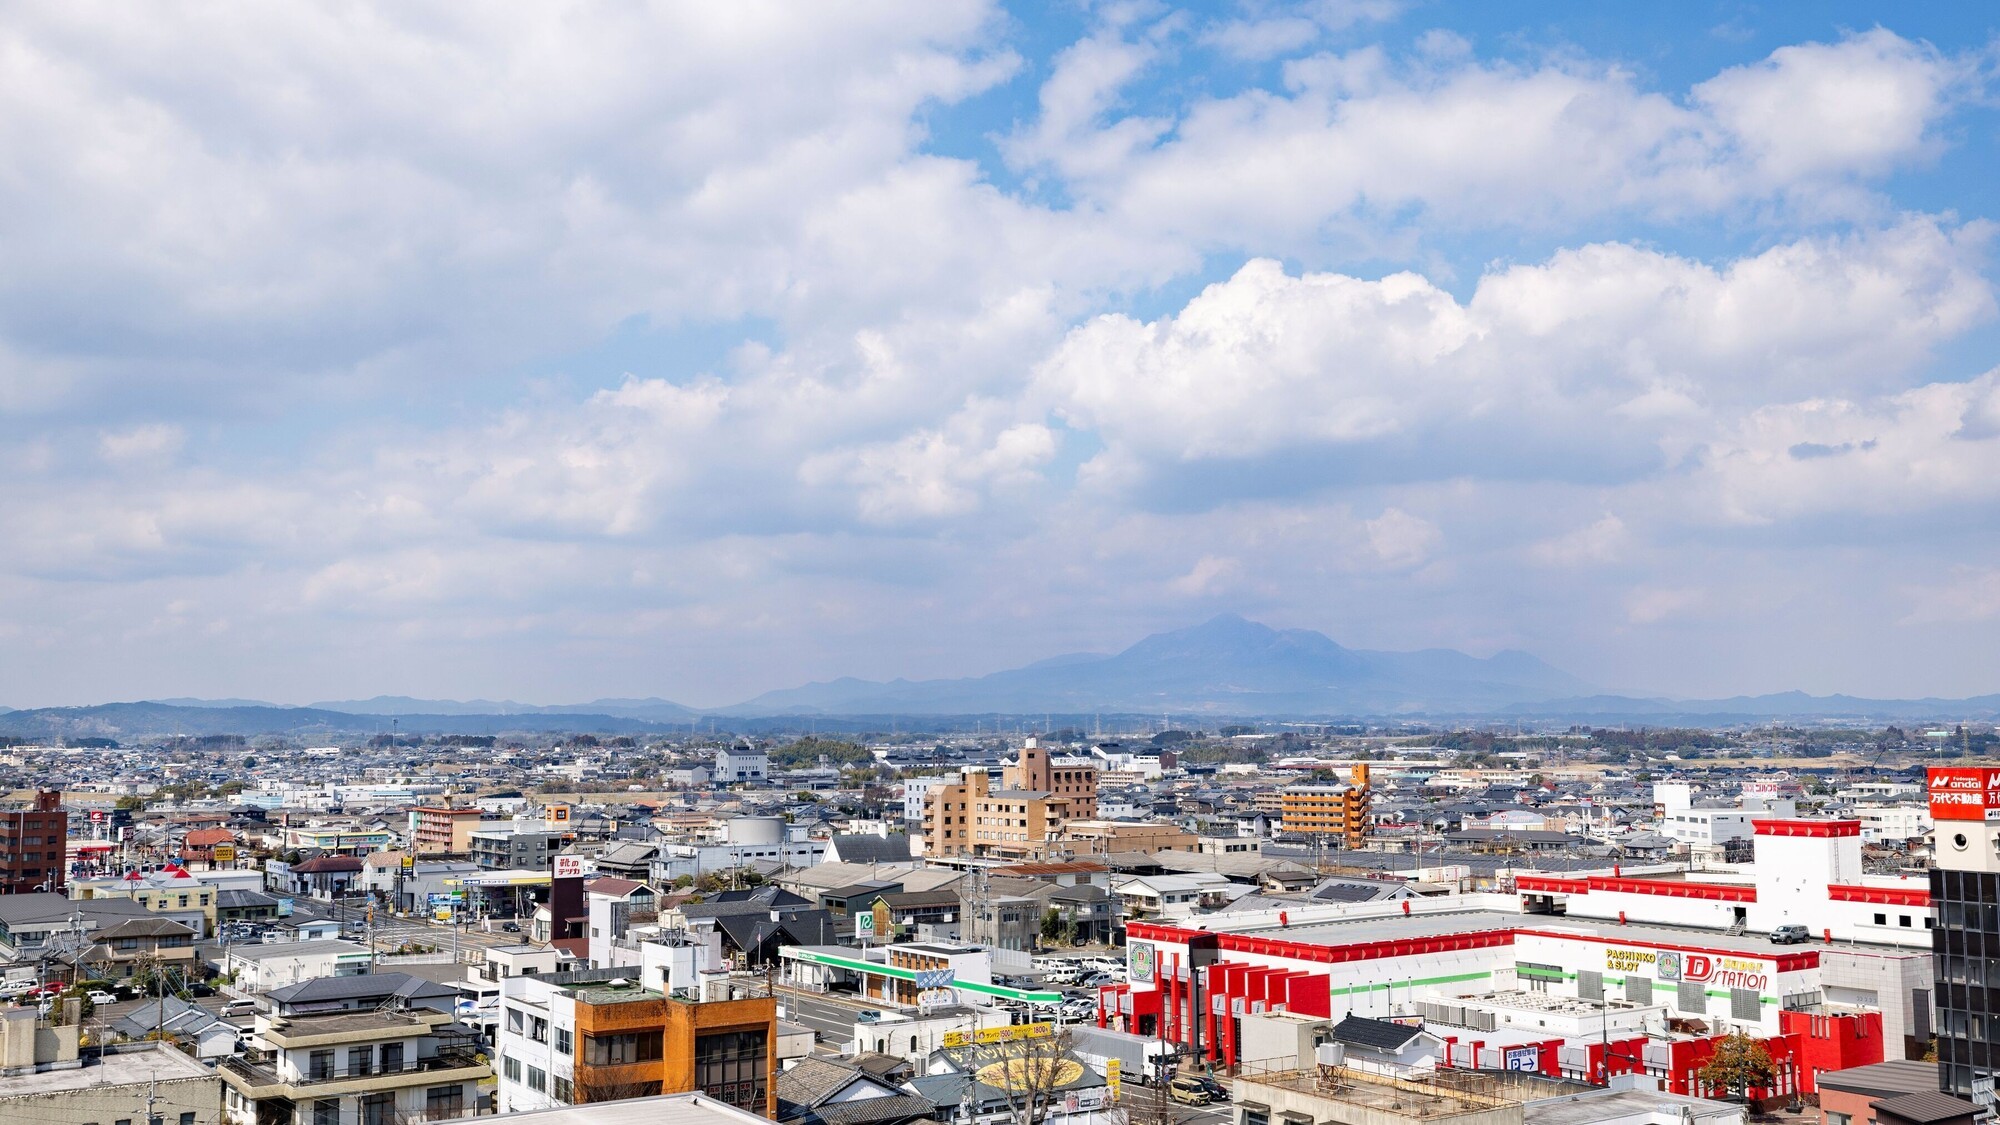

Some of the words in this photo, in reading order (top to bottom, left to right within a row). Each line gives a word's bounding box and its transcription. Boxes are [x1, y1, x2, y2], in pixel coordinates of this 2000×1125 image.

[1931, 792, 1983, 804] 万代不動産
[1606, 949, 1656, 964] PACHINKO
[1615, 961, 1639, 972] SLOT
